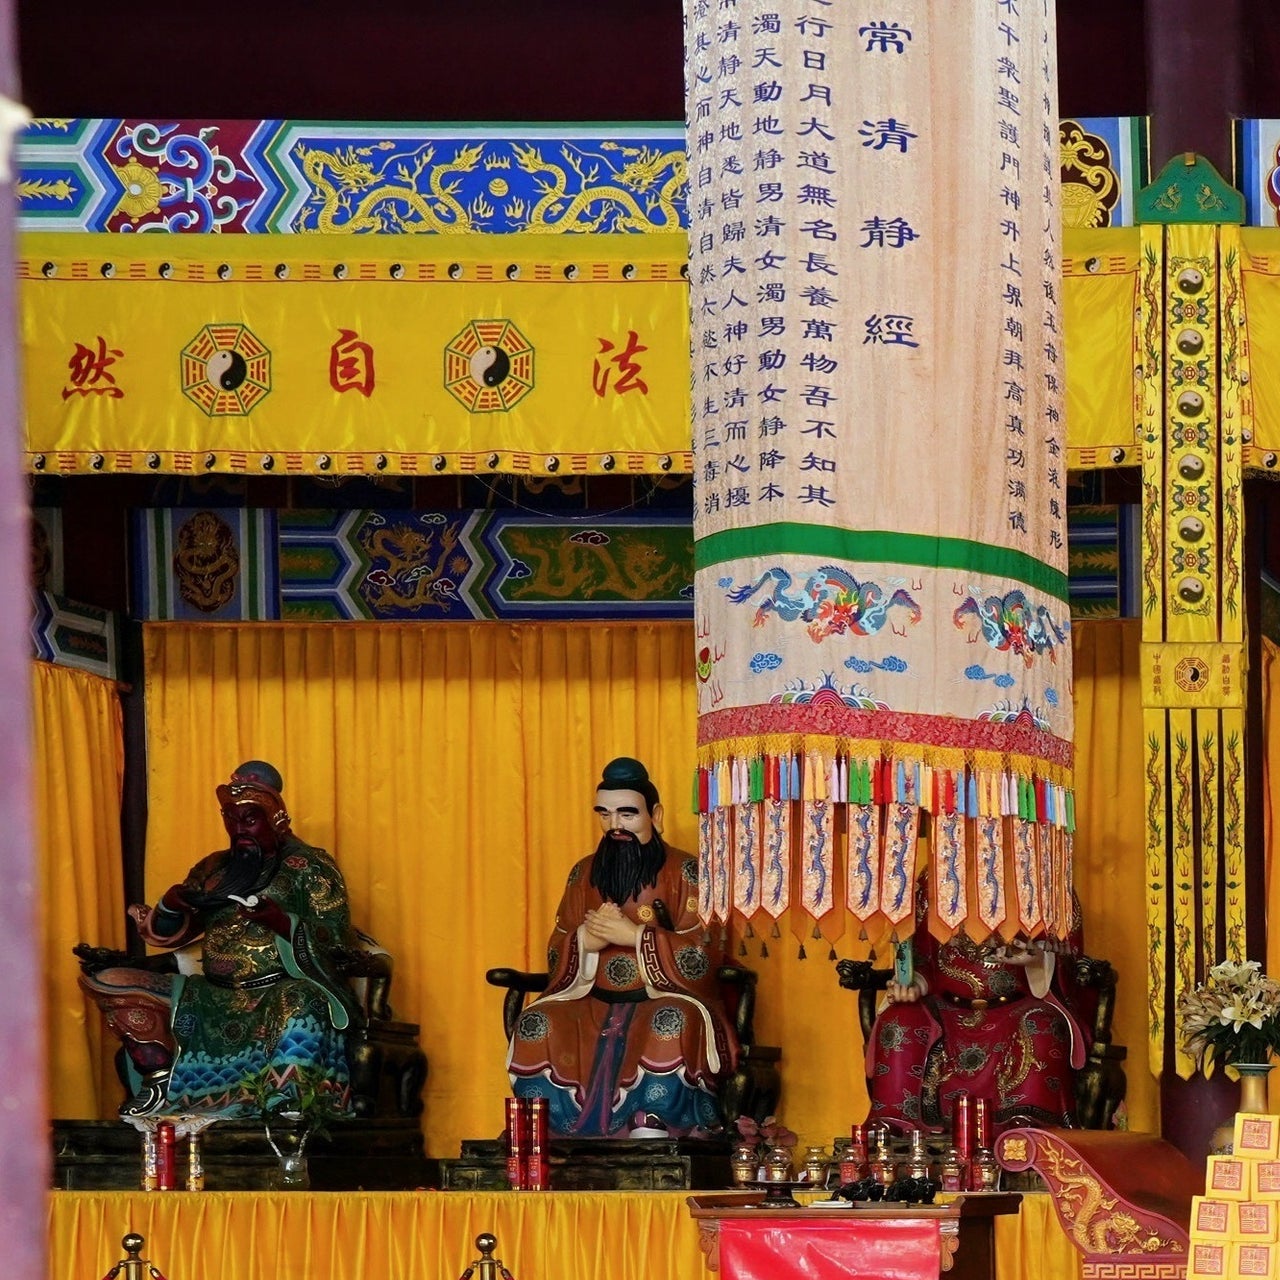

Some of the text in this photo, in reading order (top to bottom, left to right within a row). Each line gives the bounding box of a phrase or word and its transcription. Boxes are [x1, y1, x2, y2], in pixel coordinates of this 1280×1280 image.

[794, 0, 838, 508] 行日月大道無名長養萬物吾不知其
